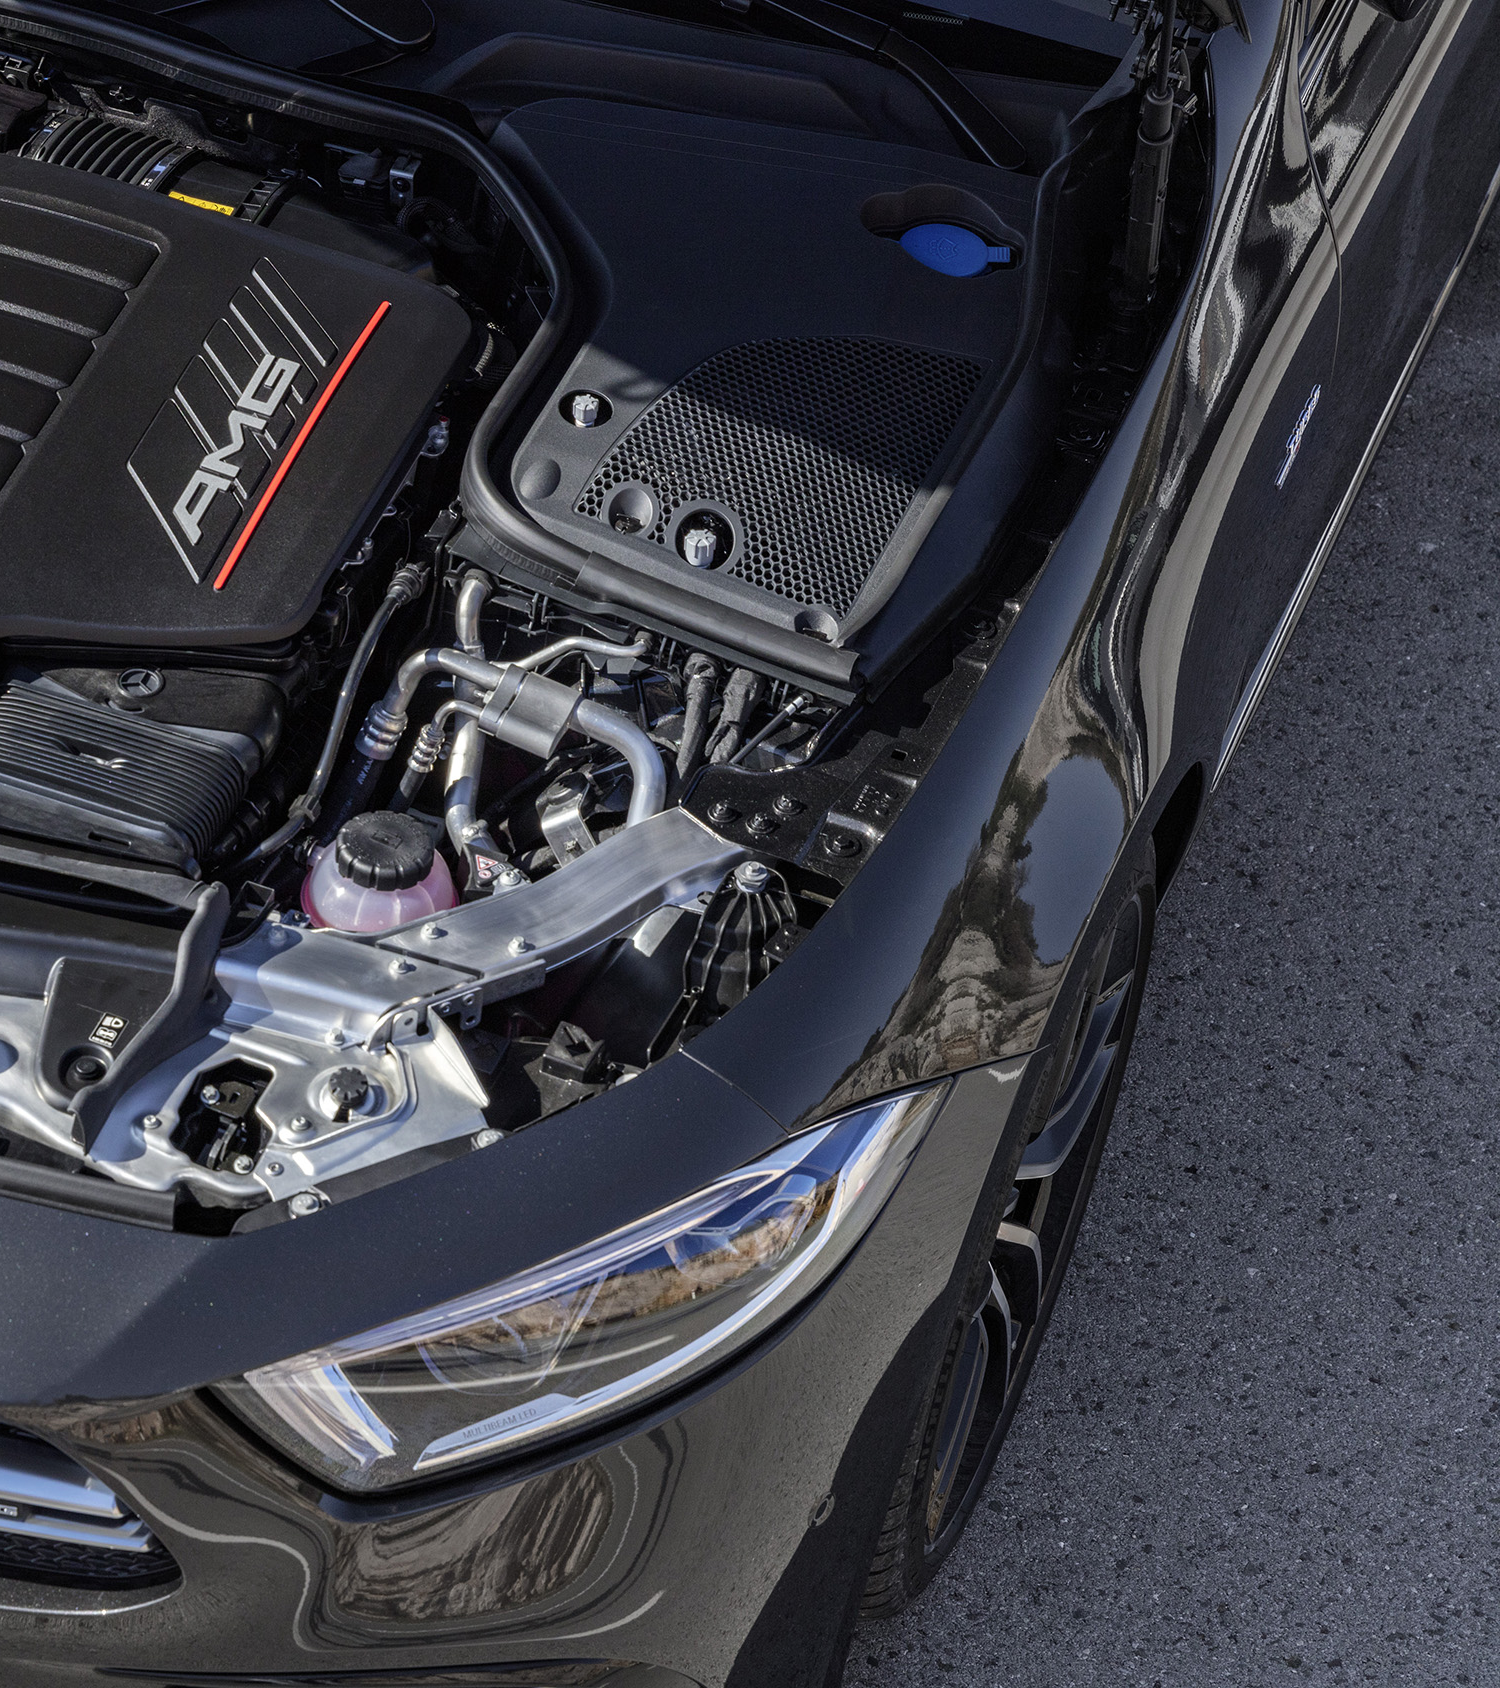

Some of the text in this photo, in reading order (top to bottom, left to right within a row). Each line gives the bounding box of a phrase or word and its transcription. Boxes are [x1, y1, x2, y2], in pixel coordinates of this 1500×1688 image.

[173, 354, 300, 545] AMG
[462, 1408, 537, 1439] MULTIBEAM LED
